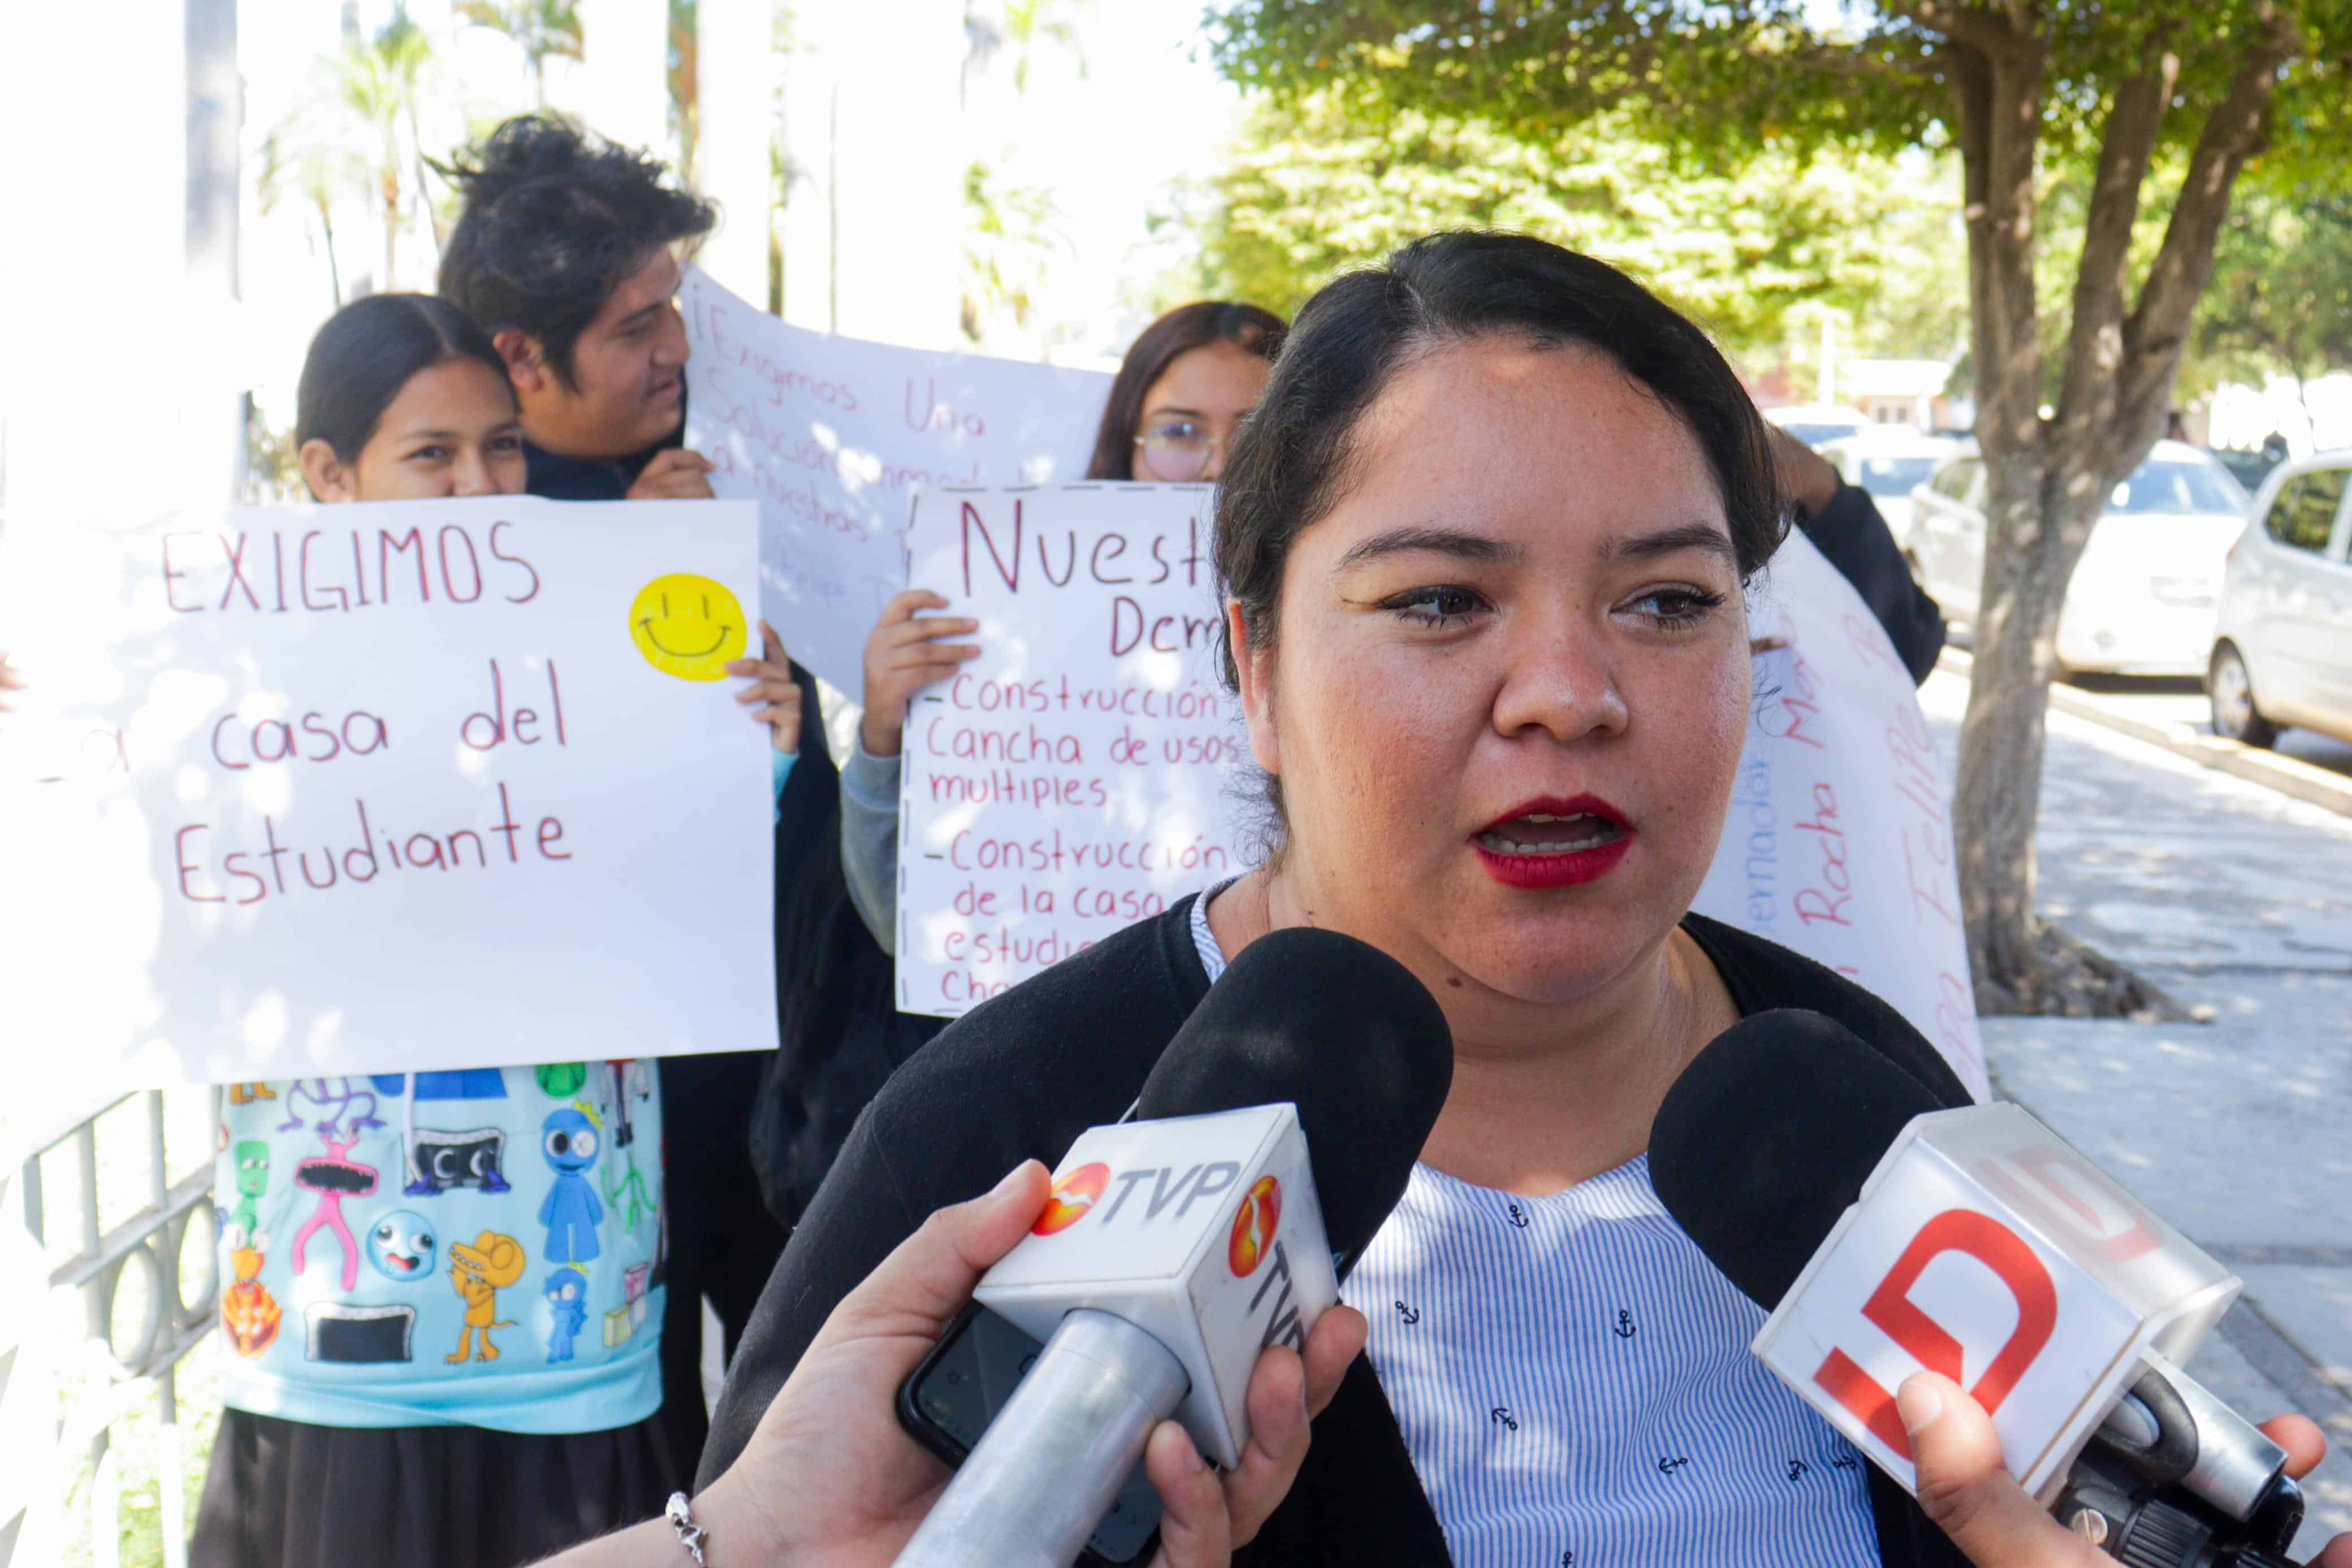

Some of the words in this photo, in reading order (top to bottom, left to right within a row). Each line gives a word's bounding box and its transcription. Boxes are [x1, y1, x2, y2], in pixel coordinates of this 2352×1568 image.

[905, 377, 985, 436] Una
[161, 519, 542, 614] EXIGIMOS
[210, 708, 390, 770] casa
[459, 659, 568, 752] del
[927, 716, 1082, 765] Cancha
[1109, 724, 1149, 766] de
[1164, 734, 1241, 765] usos
[929, 769, 1108, 809] multiples
[174, 782, 574, 906] Estudiante
[1793, 782, 1853, 926] Rocha
[954, 881, 997, 918] de
[1022, 885, 1054, 915] la
[1073, 887, 1164, 920] casa
[1102, 1160, 1241, 1223] TVP
